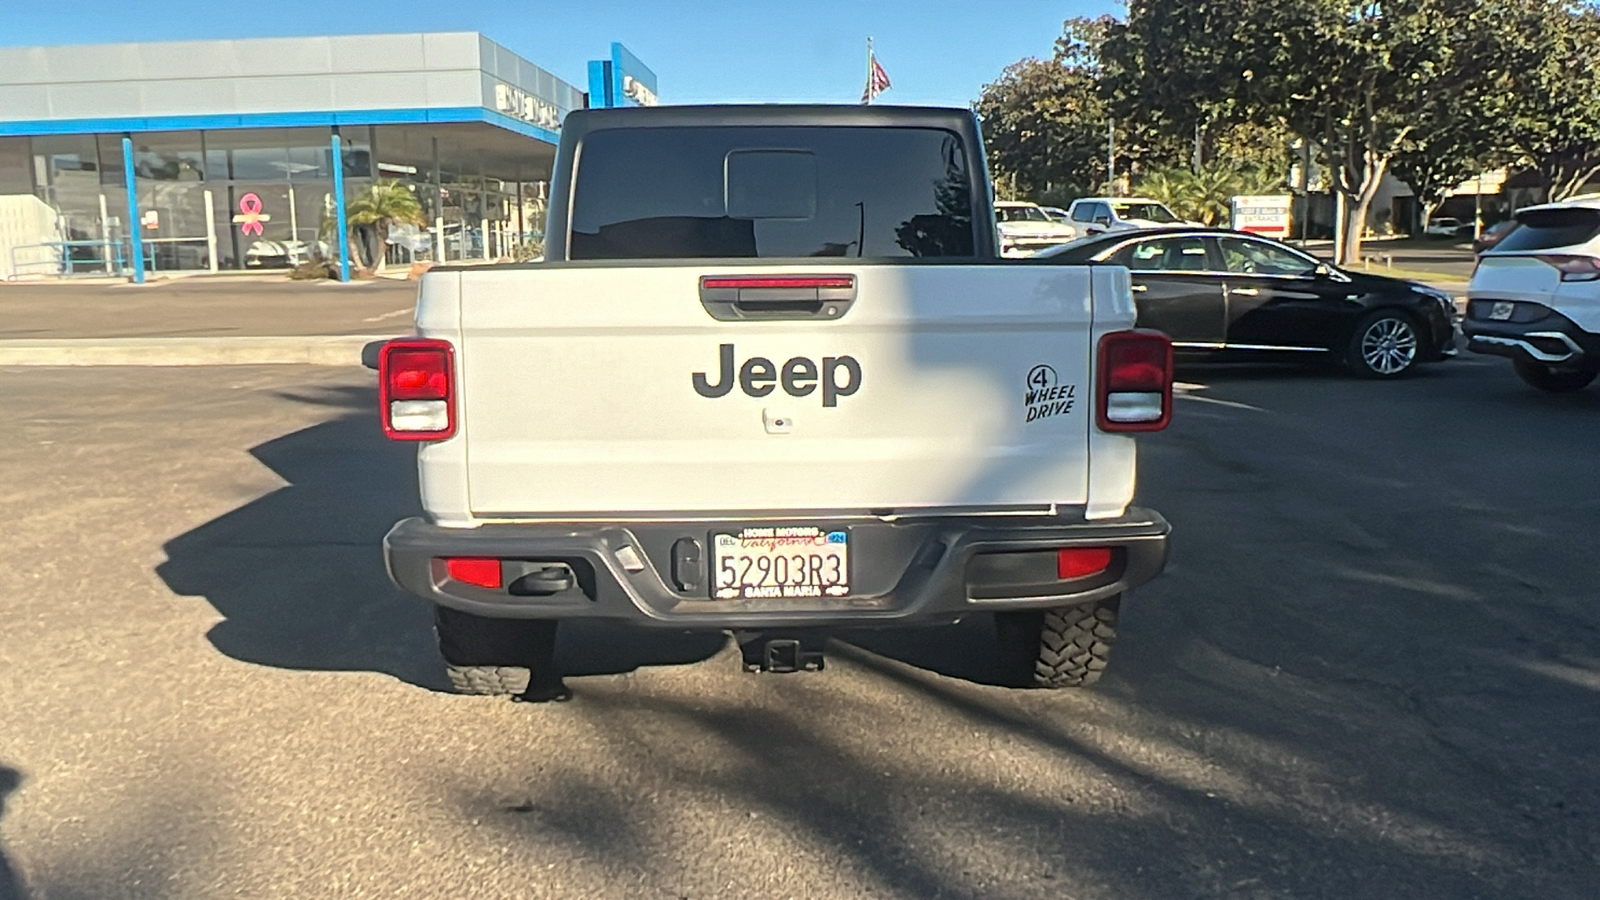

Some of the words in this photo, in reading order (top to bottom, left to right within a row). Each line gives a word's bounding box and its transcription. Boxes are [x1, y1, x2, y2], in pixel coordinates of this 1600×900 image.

[692, 343, 862, 407] Jeep
[1032, 368, 1047, 387] 4
[1025, 385, 1075, 406] WHEEL
[1026, 400, 1074, 422] DRIVE
[743, 528, 774, 537] HOME
[776, 527, 819, 537] MOTORS
[721, 554, 840, 586] 52903R3
[744, 586, 782, 598] SANTA
[783, 585, 822, 597] MARIA
